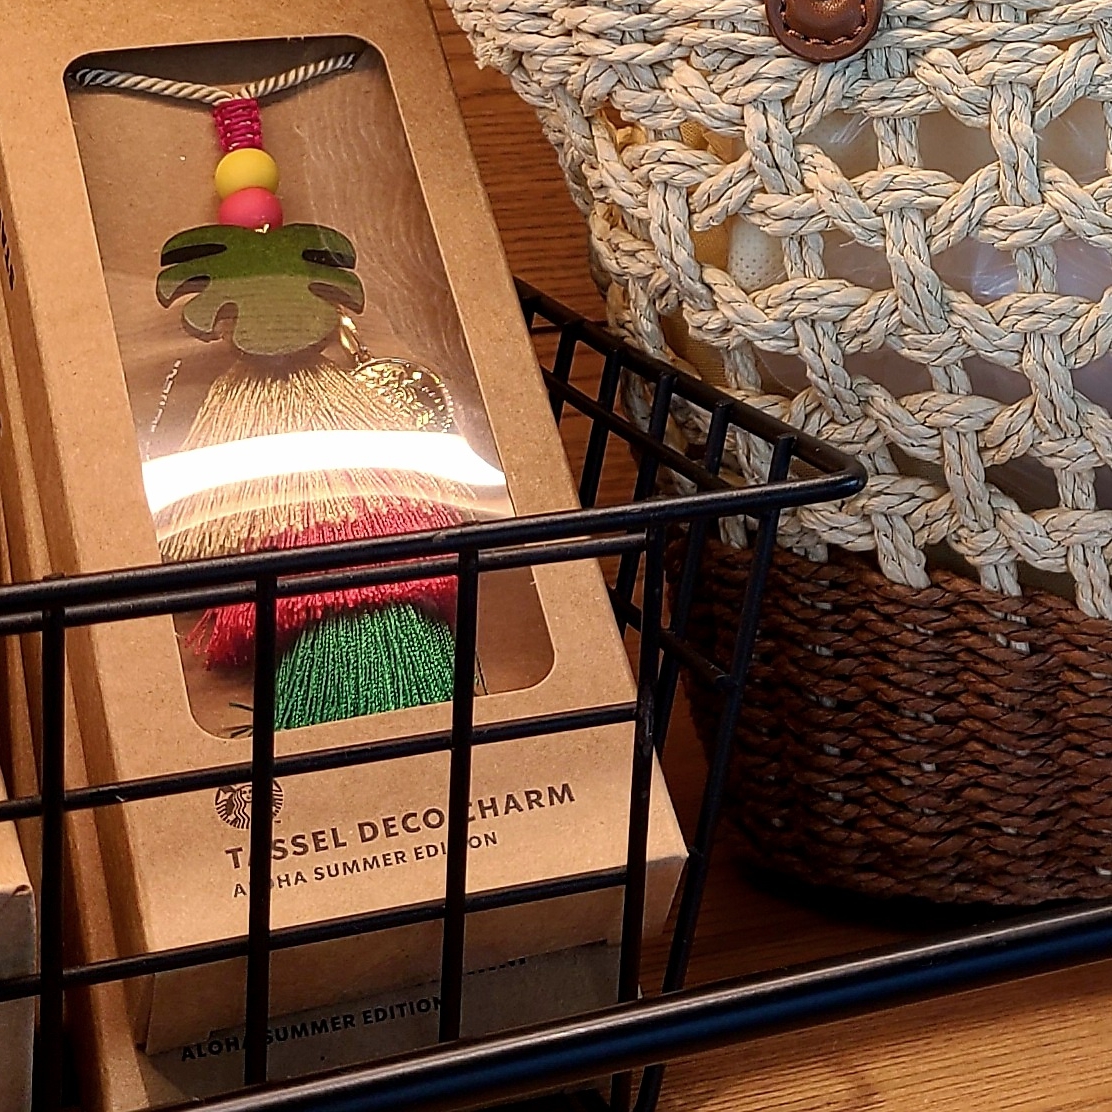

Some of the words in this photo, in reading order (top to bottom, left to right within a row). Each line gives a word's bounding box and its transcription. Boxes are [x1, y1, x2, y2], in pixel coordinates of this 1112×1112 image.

[225, 827, 348, 869] TSSEL
[357, 807, 446, 843] DECO
[233, 870, 308, 898] AHA
[314, 850, 408, 881] SUMMER
[414, 831, 498, 861] EDION
[266, 1013, 356, 1045] SUMMER
